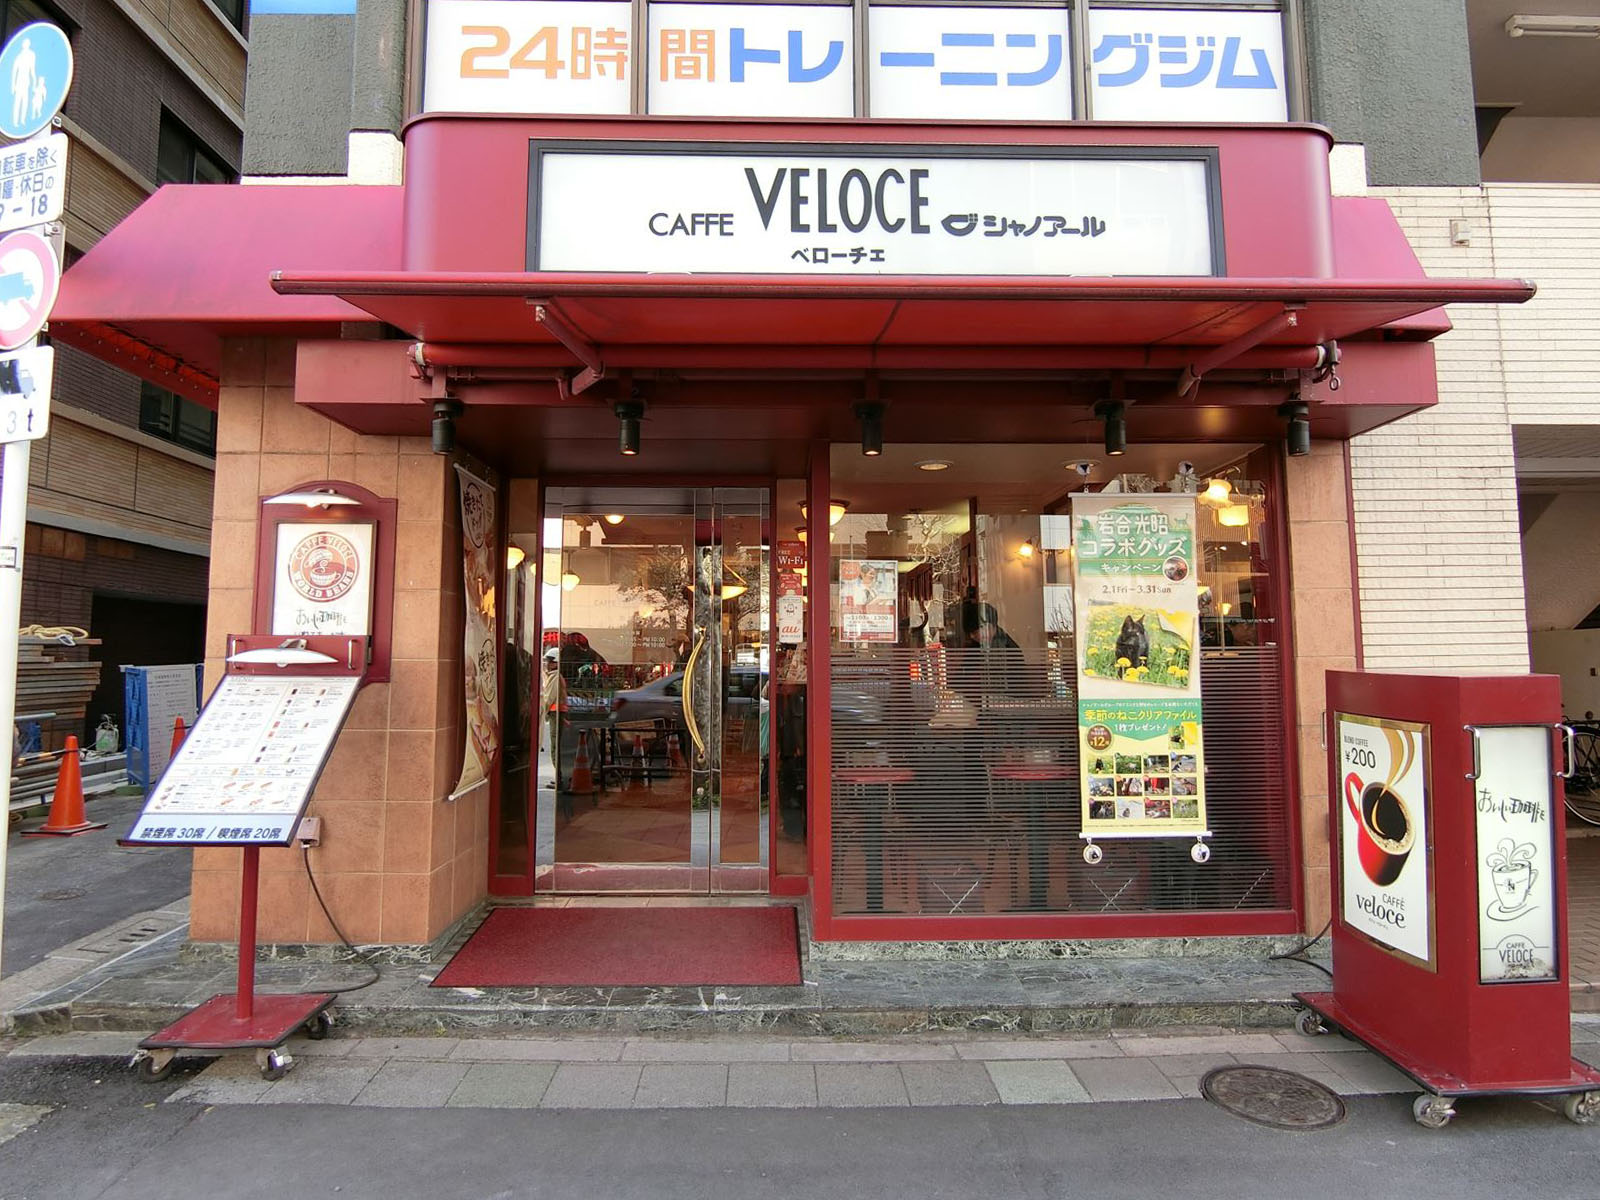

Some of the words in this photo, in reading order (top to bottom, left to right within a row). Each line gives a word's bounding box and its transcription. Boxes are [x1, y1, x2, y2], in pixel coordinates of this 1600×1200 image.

[0, 146, 57, 175] 転車を除く
[0, 172, 55, 199] 曜・休日の
[648, 212, 734, 236] CAFFE
[744, 167, 931, 234] VELOCE
[983, 215, 1106, 238] シャノアール
[790, 246, 885, 265] ベローチェ
[1082, 536, 1187, 556] コラボグッズ
[778, 556, 804, 565] Wi-Fi
[1101, 562, 1161, 573] キャンペーン
[781, 625, 800, 634] au
[1356, 894, 1407, 929] veloce
[1499, 949, 1533, 963] VELOCE
